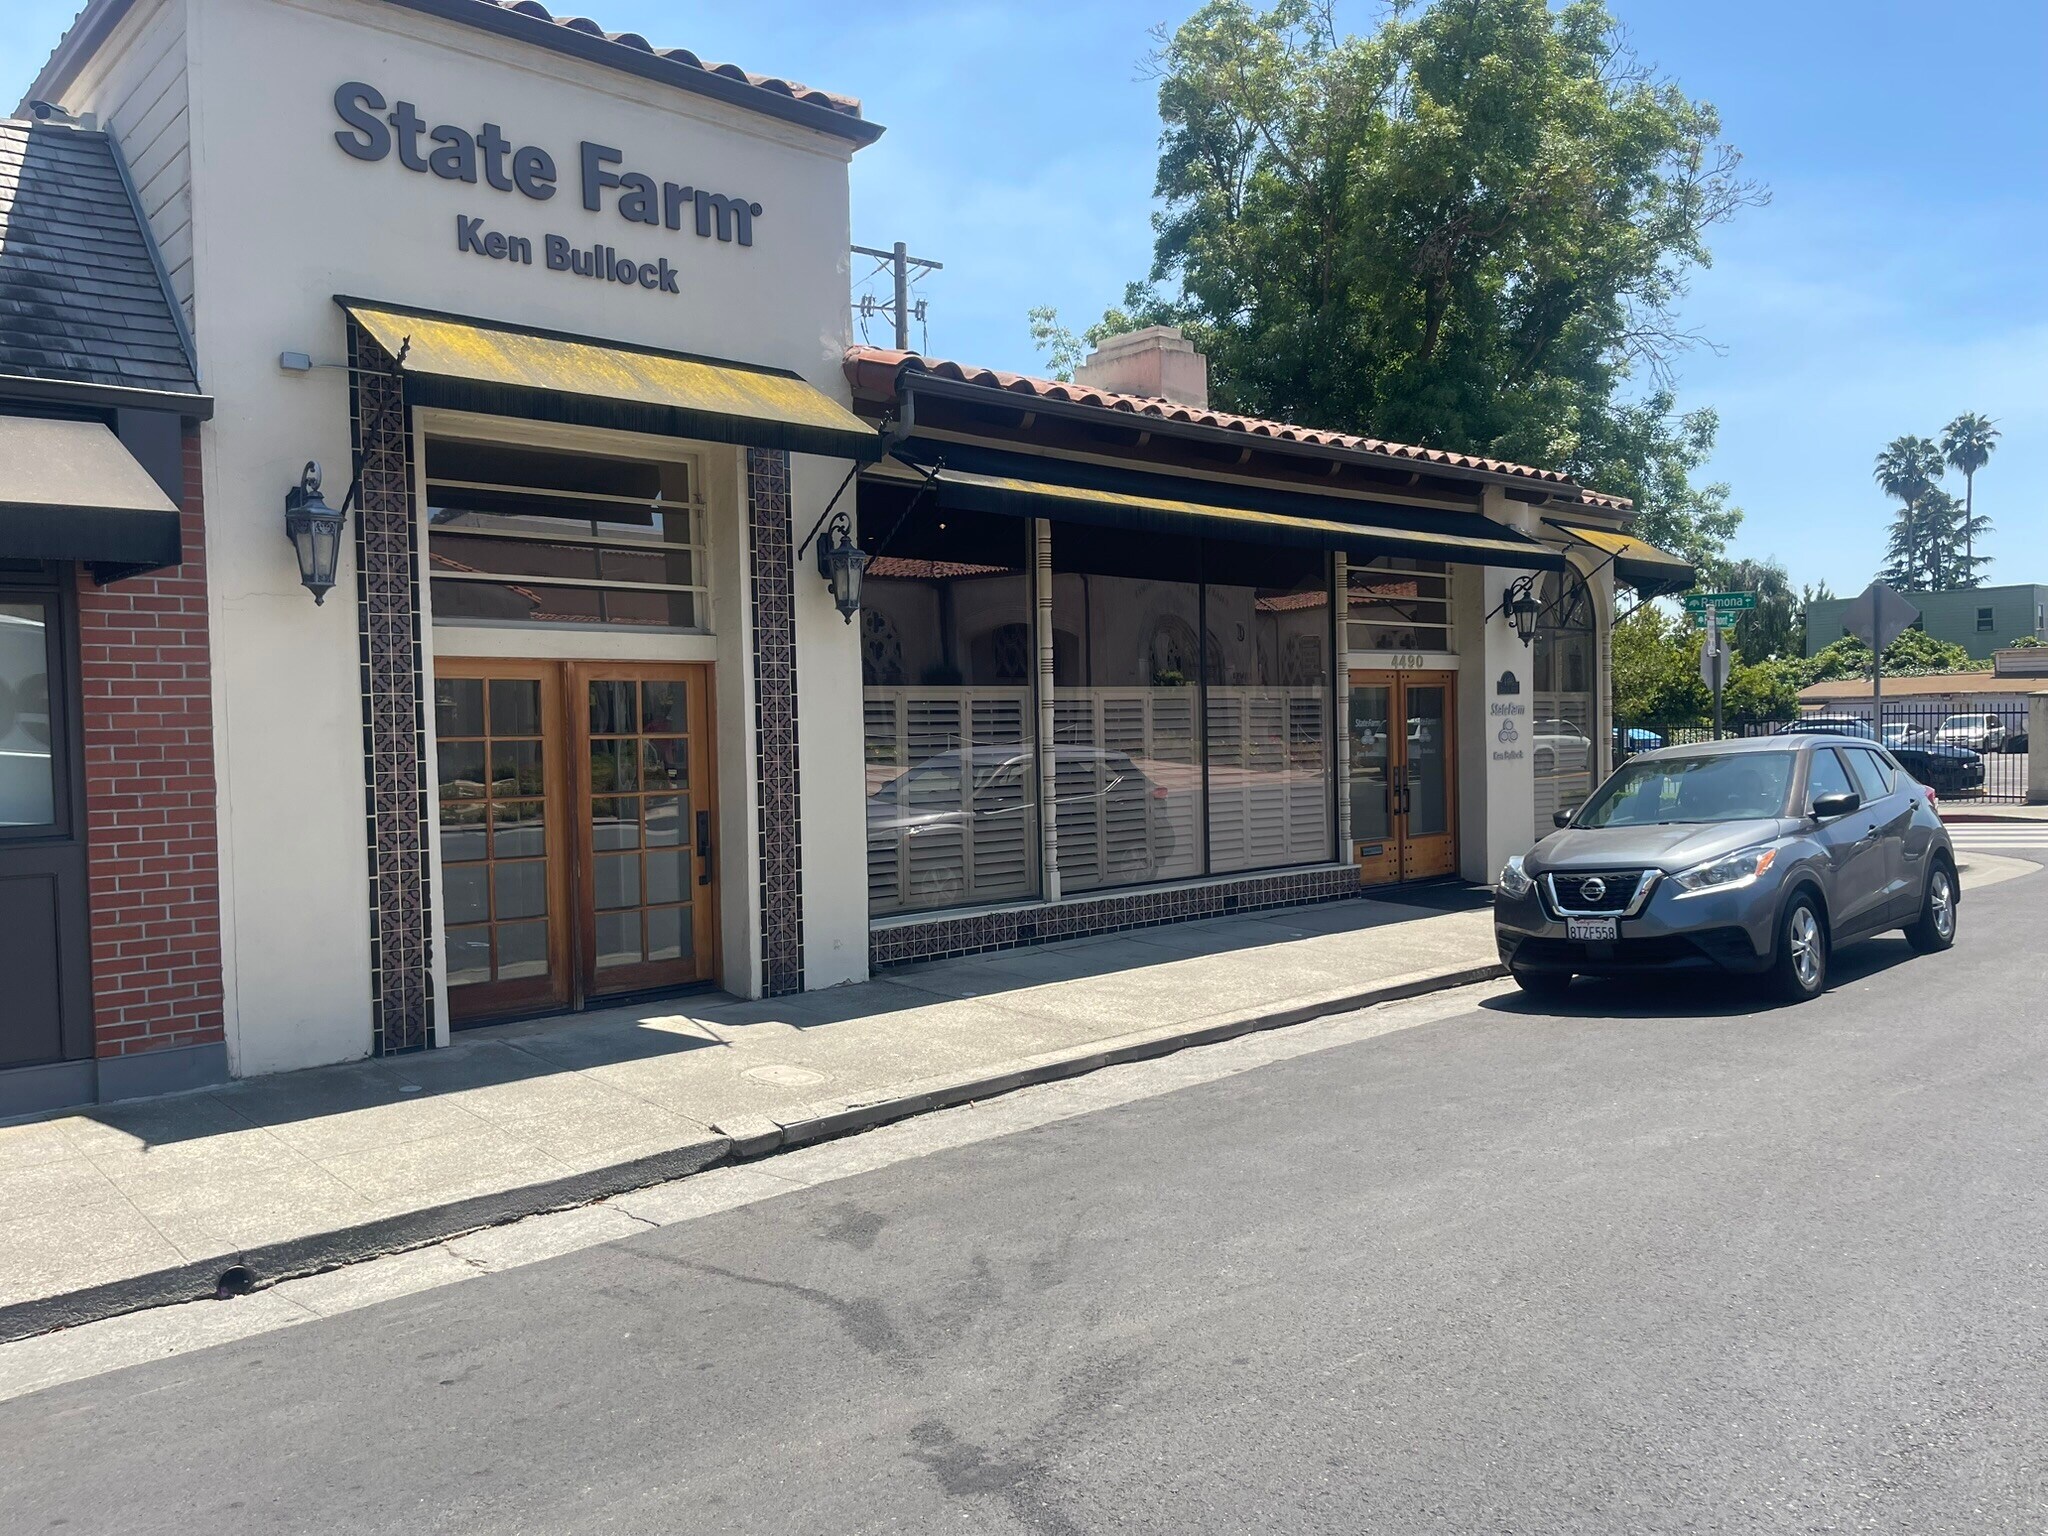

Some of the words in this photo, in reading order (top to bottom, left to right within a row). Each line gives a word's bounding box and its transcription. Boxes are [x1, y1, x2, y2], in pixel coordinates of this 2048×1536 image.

[333, 81, 558, 200] State
[457, 213, 532, 265] Ken
[545, 233, 680, 294] Bullock
[1701, 597, 1743, 607] Ramona
[1390, 654, 1424, 669] 4490
[1570, 926, 1615, 940] 8TZF558
